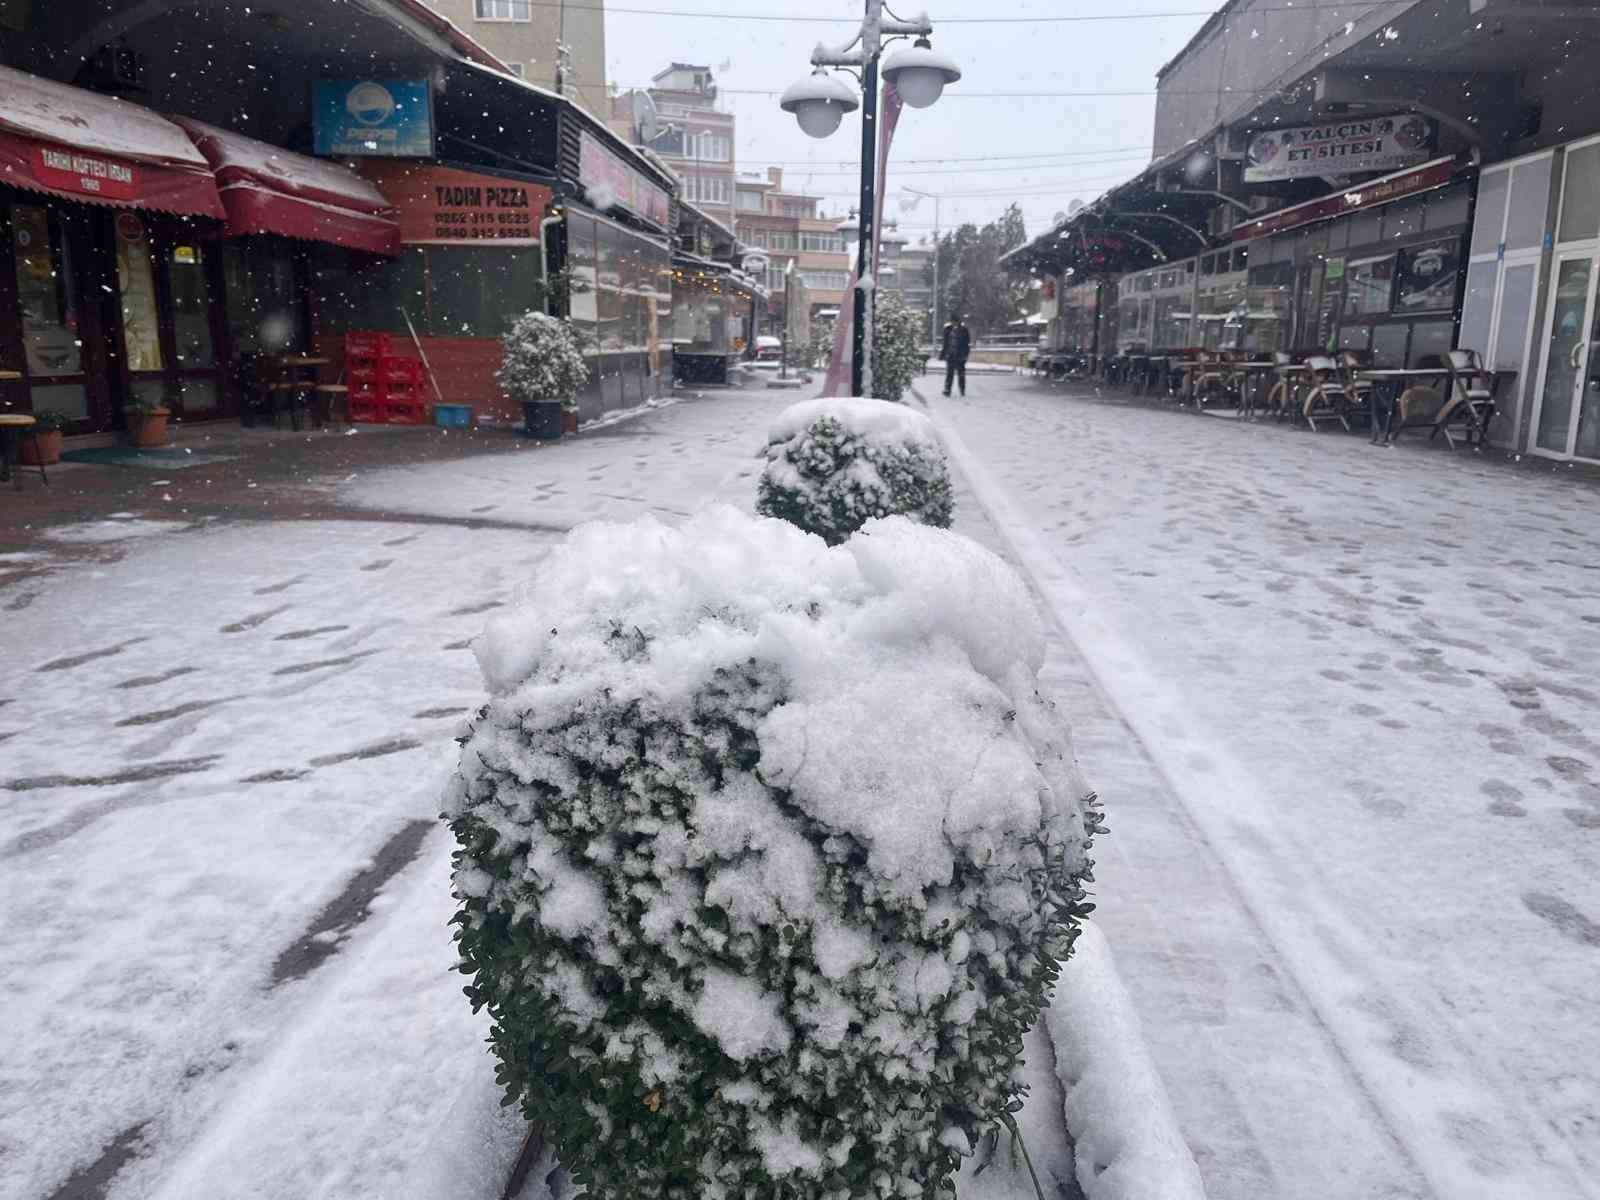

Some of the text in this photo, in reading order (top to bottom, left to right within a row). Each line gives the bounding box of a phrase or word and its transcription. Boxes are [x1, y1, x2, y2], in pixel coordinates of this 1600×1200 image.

[1301, 120, 1374, 144] YALÇIN
[1287, 138, 1384, 162] ET SİTESİ
[435, 186, 481, 207] TADIM
